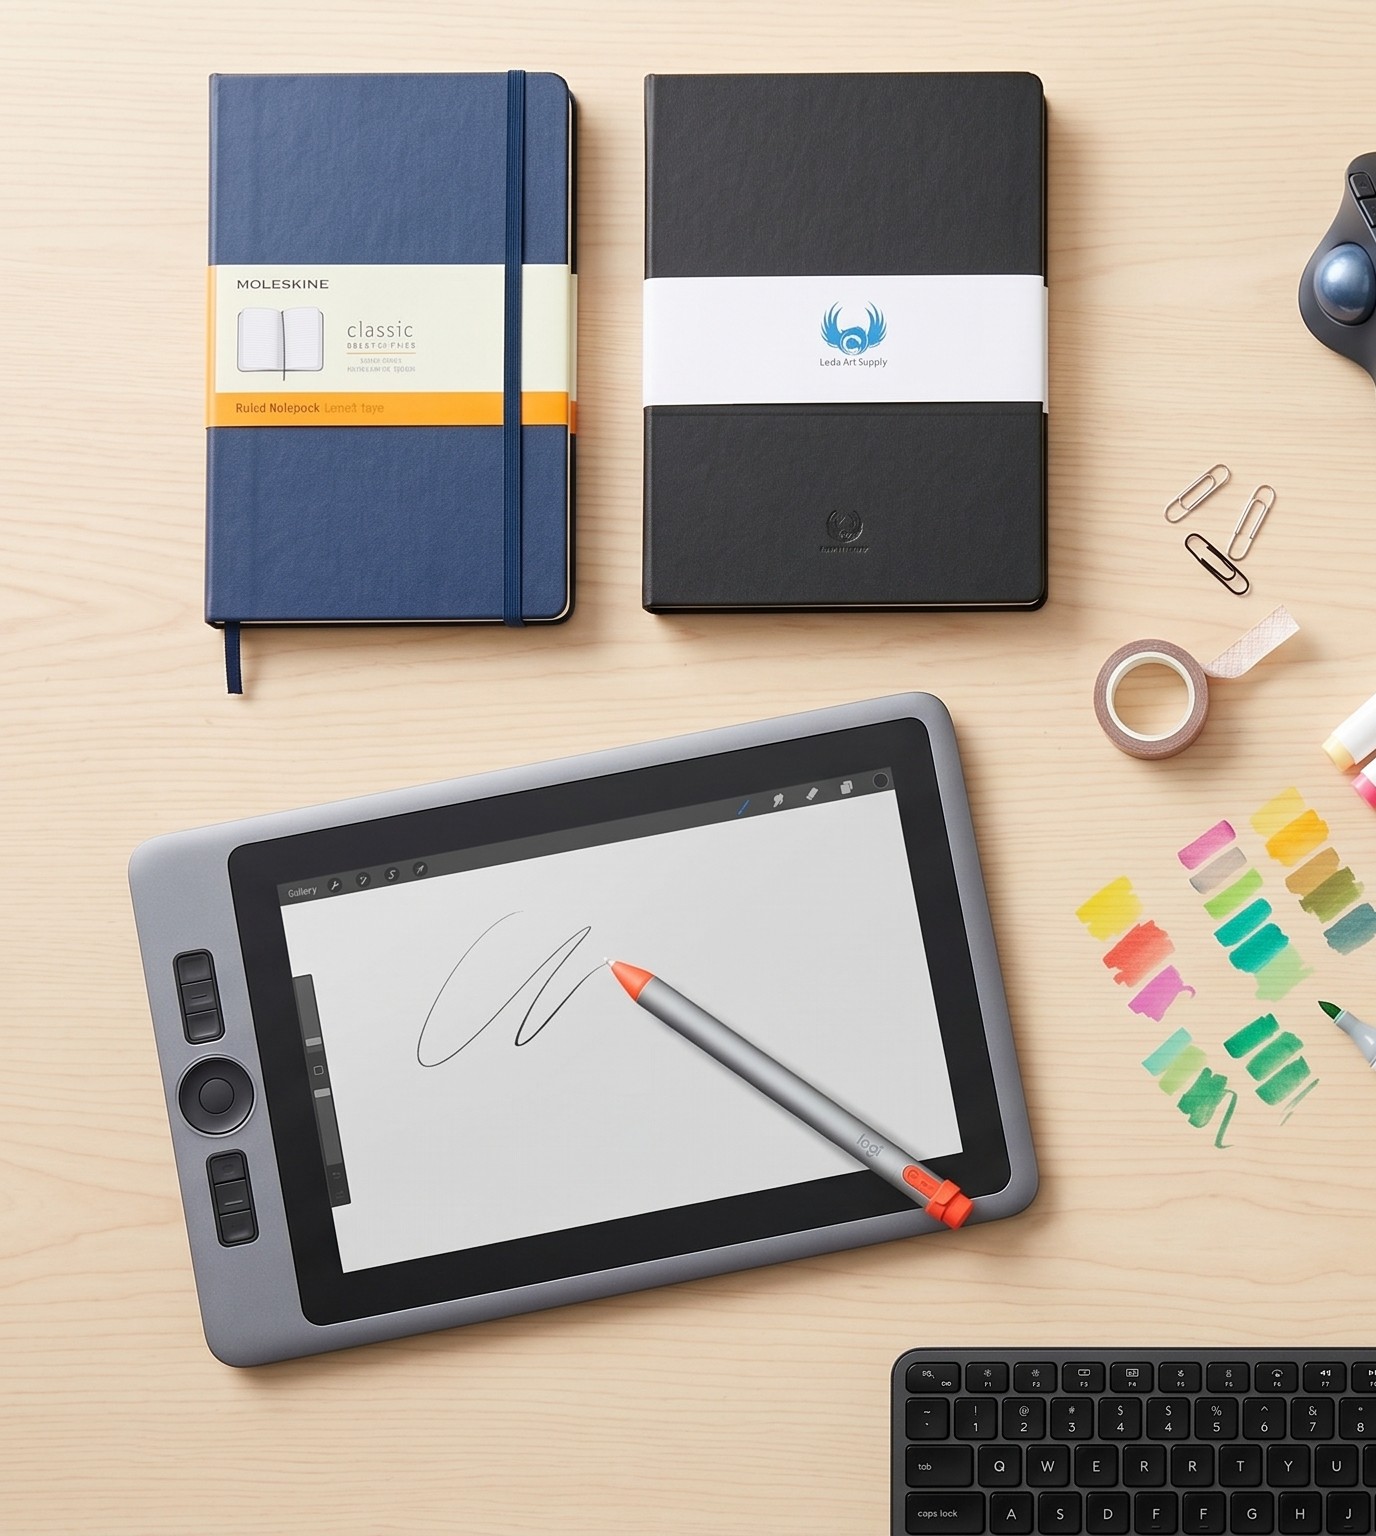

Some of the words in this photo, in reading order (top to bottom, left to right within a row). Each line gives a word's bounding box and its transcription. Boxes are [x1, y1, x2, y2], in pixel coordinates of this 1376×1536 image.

[237, 279, 329, 289] MOLESKINE
[347, 320, 413, 338] classic
[820, 358, 841, 366] Leda
[843, 358, 857, 366] Art
[858, 357, 888, 368] Supply
[288, 886, 317, 898] Gallery
[856, 1133, 884, 1158] logi
[1308, 1405, 1318, 1416] &
[973, 1422, 978, 1433] 1
[1020, 1422, 1028, 1433] 2
[1068, 1422, 1076, 1433] 3
[1116, 1422, 1125, 1433] 4
[1164, 1422, 1173, 1433] 4
[1212, 1421, 1221, 1433] 5
[1260, 1421, 1269, 1433] 6
[1309, 1421, 1317, 1432] 7
[1356, 1422, 1365, 1433] 8
[993, 1460, 1005, 1473] Q
[1040, 1460, 1055, 1472] W
[1092, 1460, 1101, 1472] E
[1140, 1460, 1149, 1472] R
[1188, 1460, 1197, 1472] R
[1236, 1460, 1245, 1472] T
[1283, 1460, 1293, 1472] Y
[1332, 1460, 1342, 1472] U
[939, 1509, 958, 1518] lock
[1006, 1508, 1017, 1520] A
[1056, 1508, 1064, 1520] S
[1103, 1508, 1113, 1520] D
[1152, 1508, 1161, 1520] F
[1200, 1508, 1208, 1520] F
[1246, 1508, 1257, 1520] G
[1295, 1508, 1305, 1520] H
[1345, 1508, 1352, 1520] J
